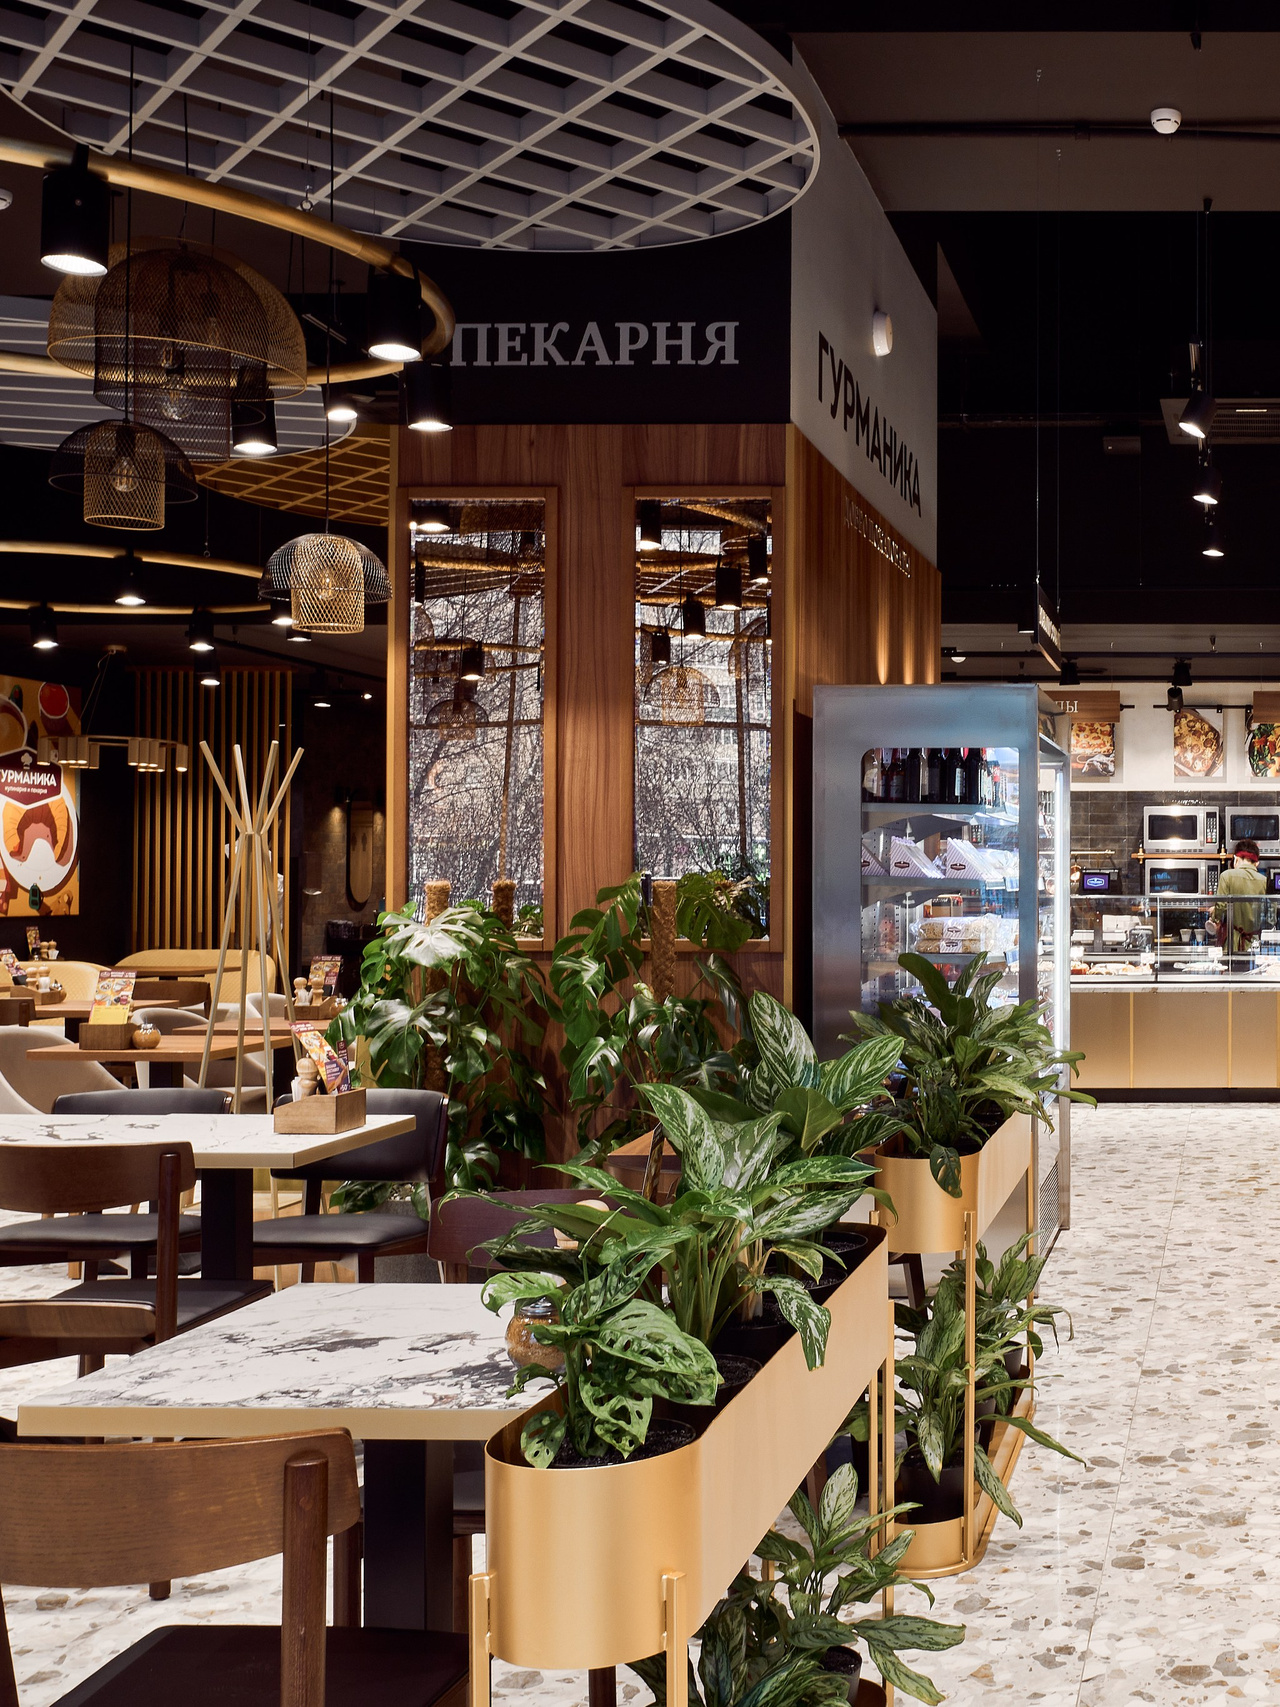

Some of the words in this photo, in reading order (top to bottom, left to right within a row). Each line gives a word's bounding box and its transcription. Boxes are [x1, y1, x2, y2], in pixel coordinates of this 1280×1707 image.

[449, 321, 739, 367] ПЕКАРНЯ
[817, 330, 922, 518] ГУРМАНИКА
[0, 769, 57, 787] УРМАНИКА
